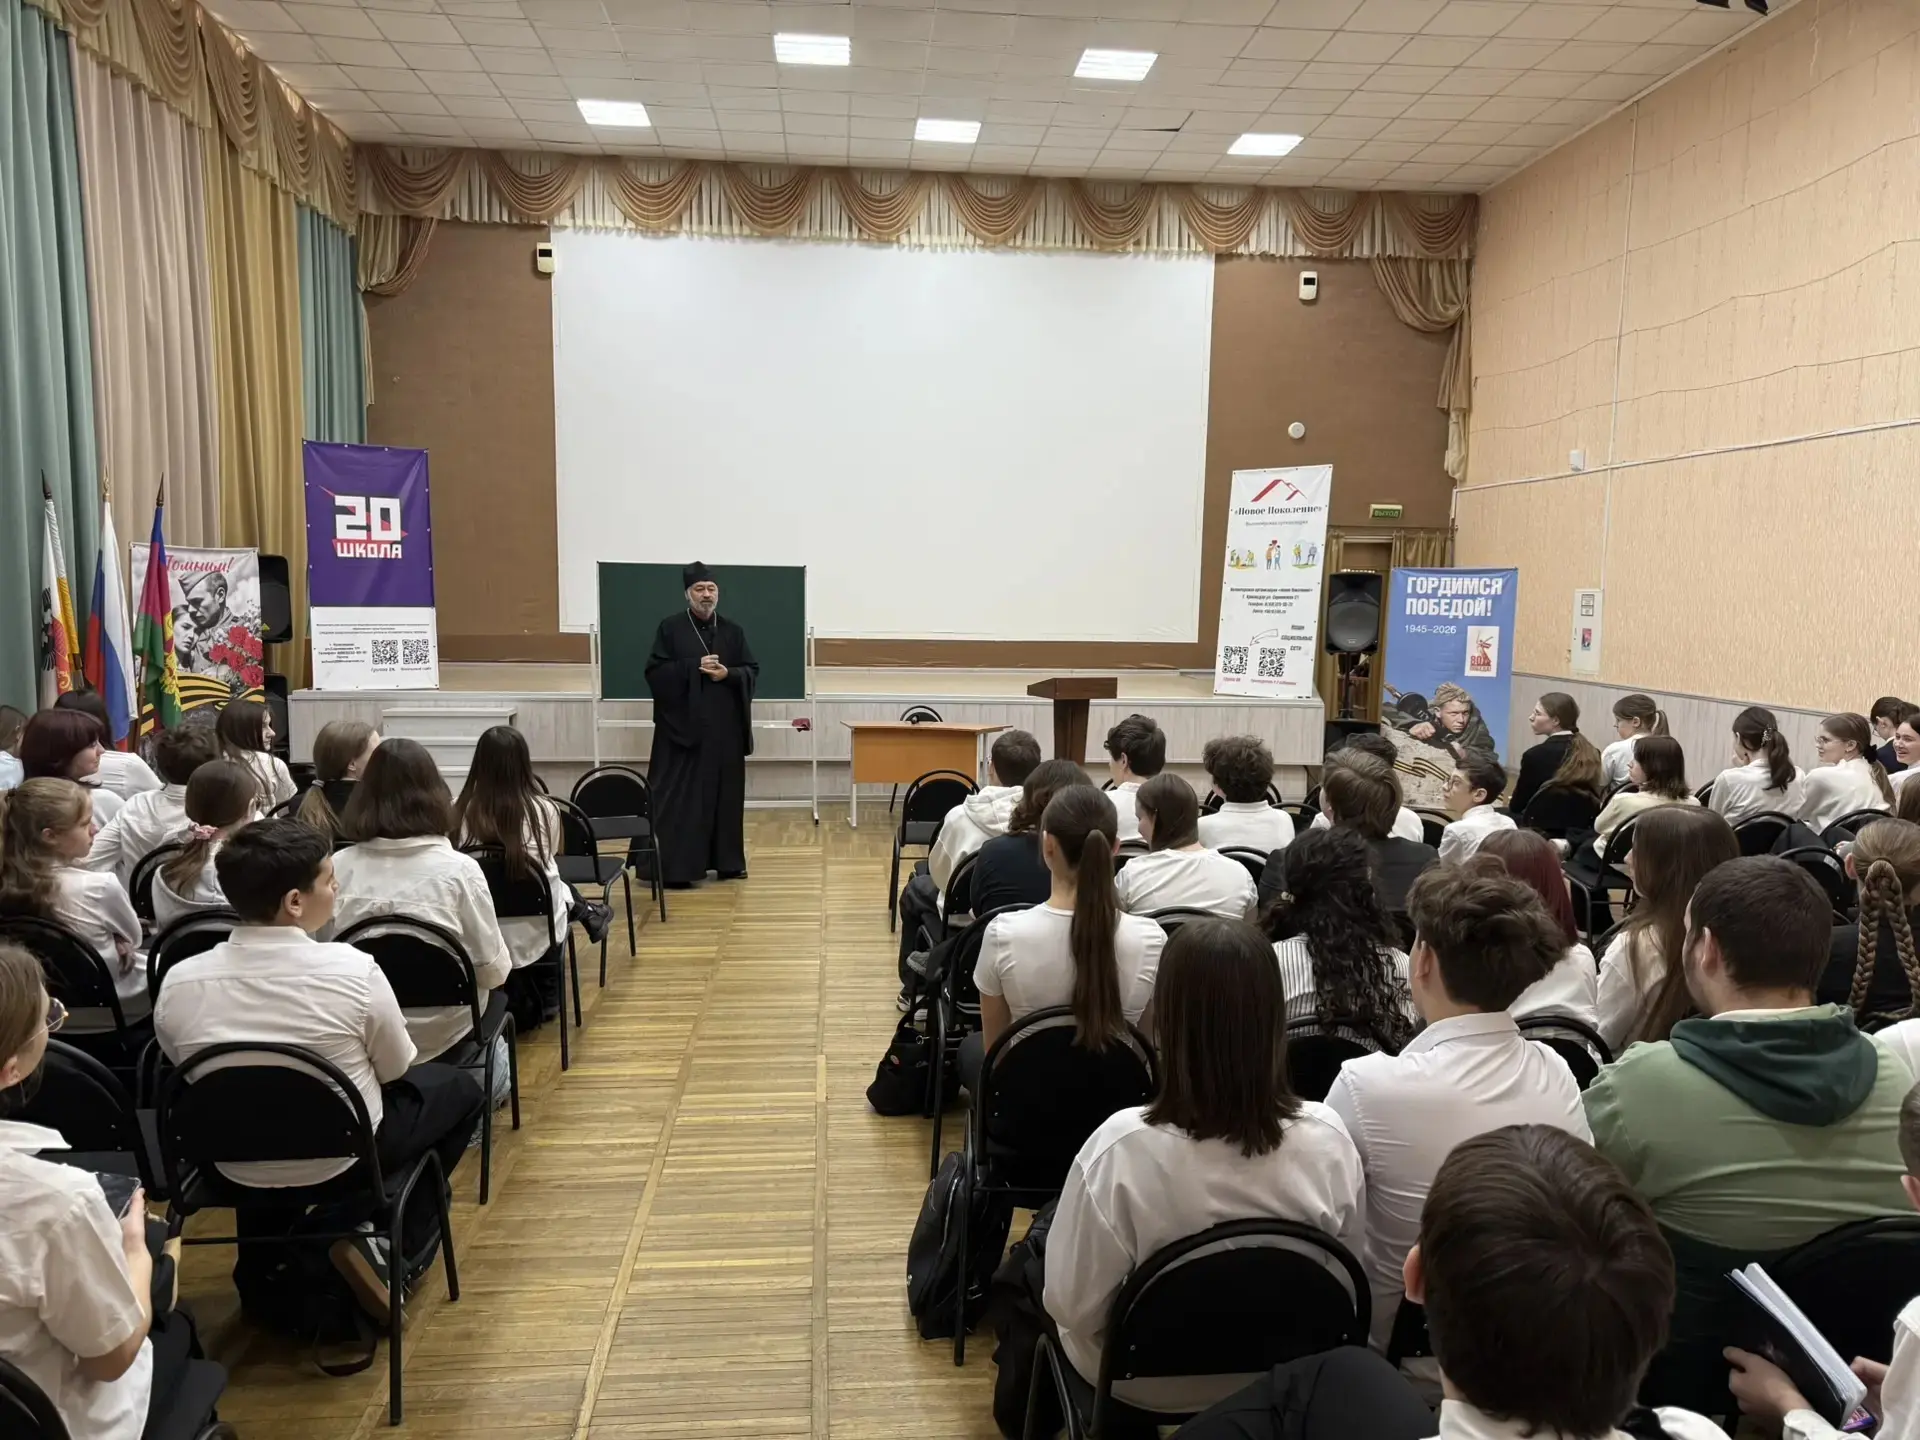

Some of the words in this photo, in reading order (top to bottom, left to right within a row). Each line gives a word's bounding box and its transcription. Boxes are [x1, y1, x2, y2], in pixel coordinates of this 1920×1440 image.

[335, 495, 401, 541] 20
[336, 542, 402, 559] ШКОЛА
[1406, 577, 1503, 597] ГОРДИМСЯ
[1405, 597, 1493, 619] ПОБЕДОЙ!
